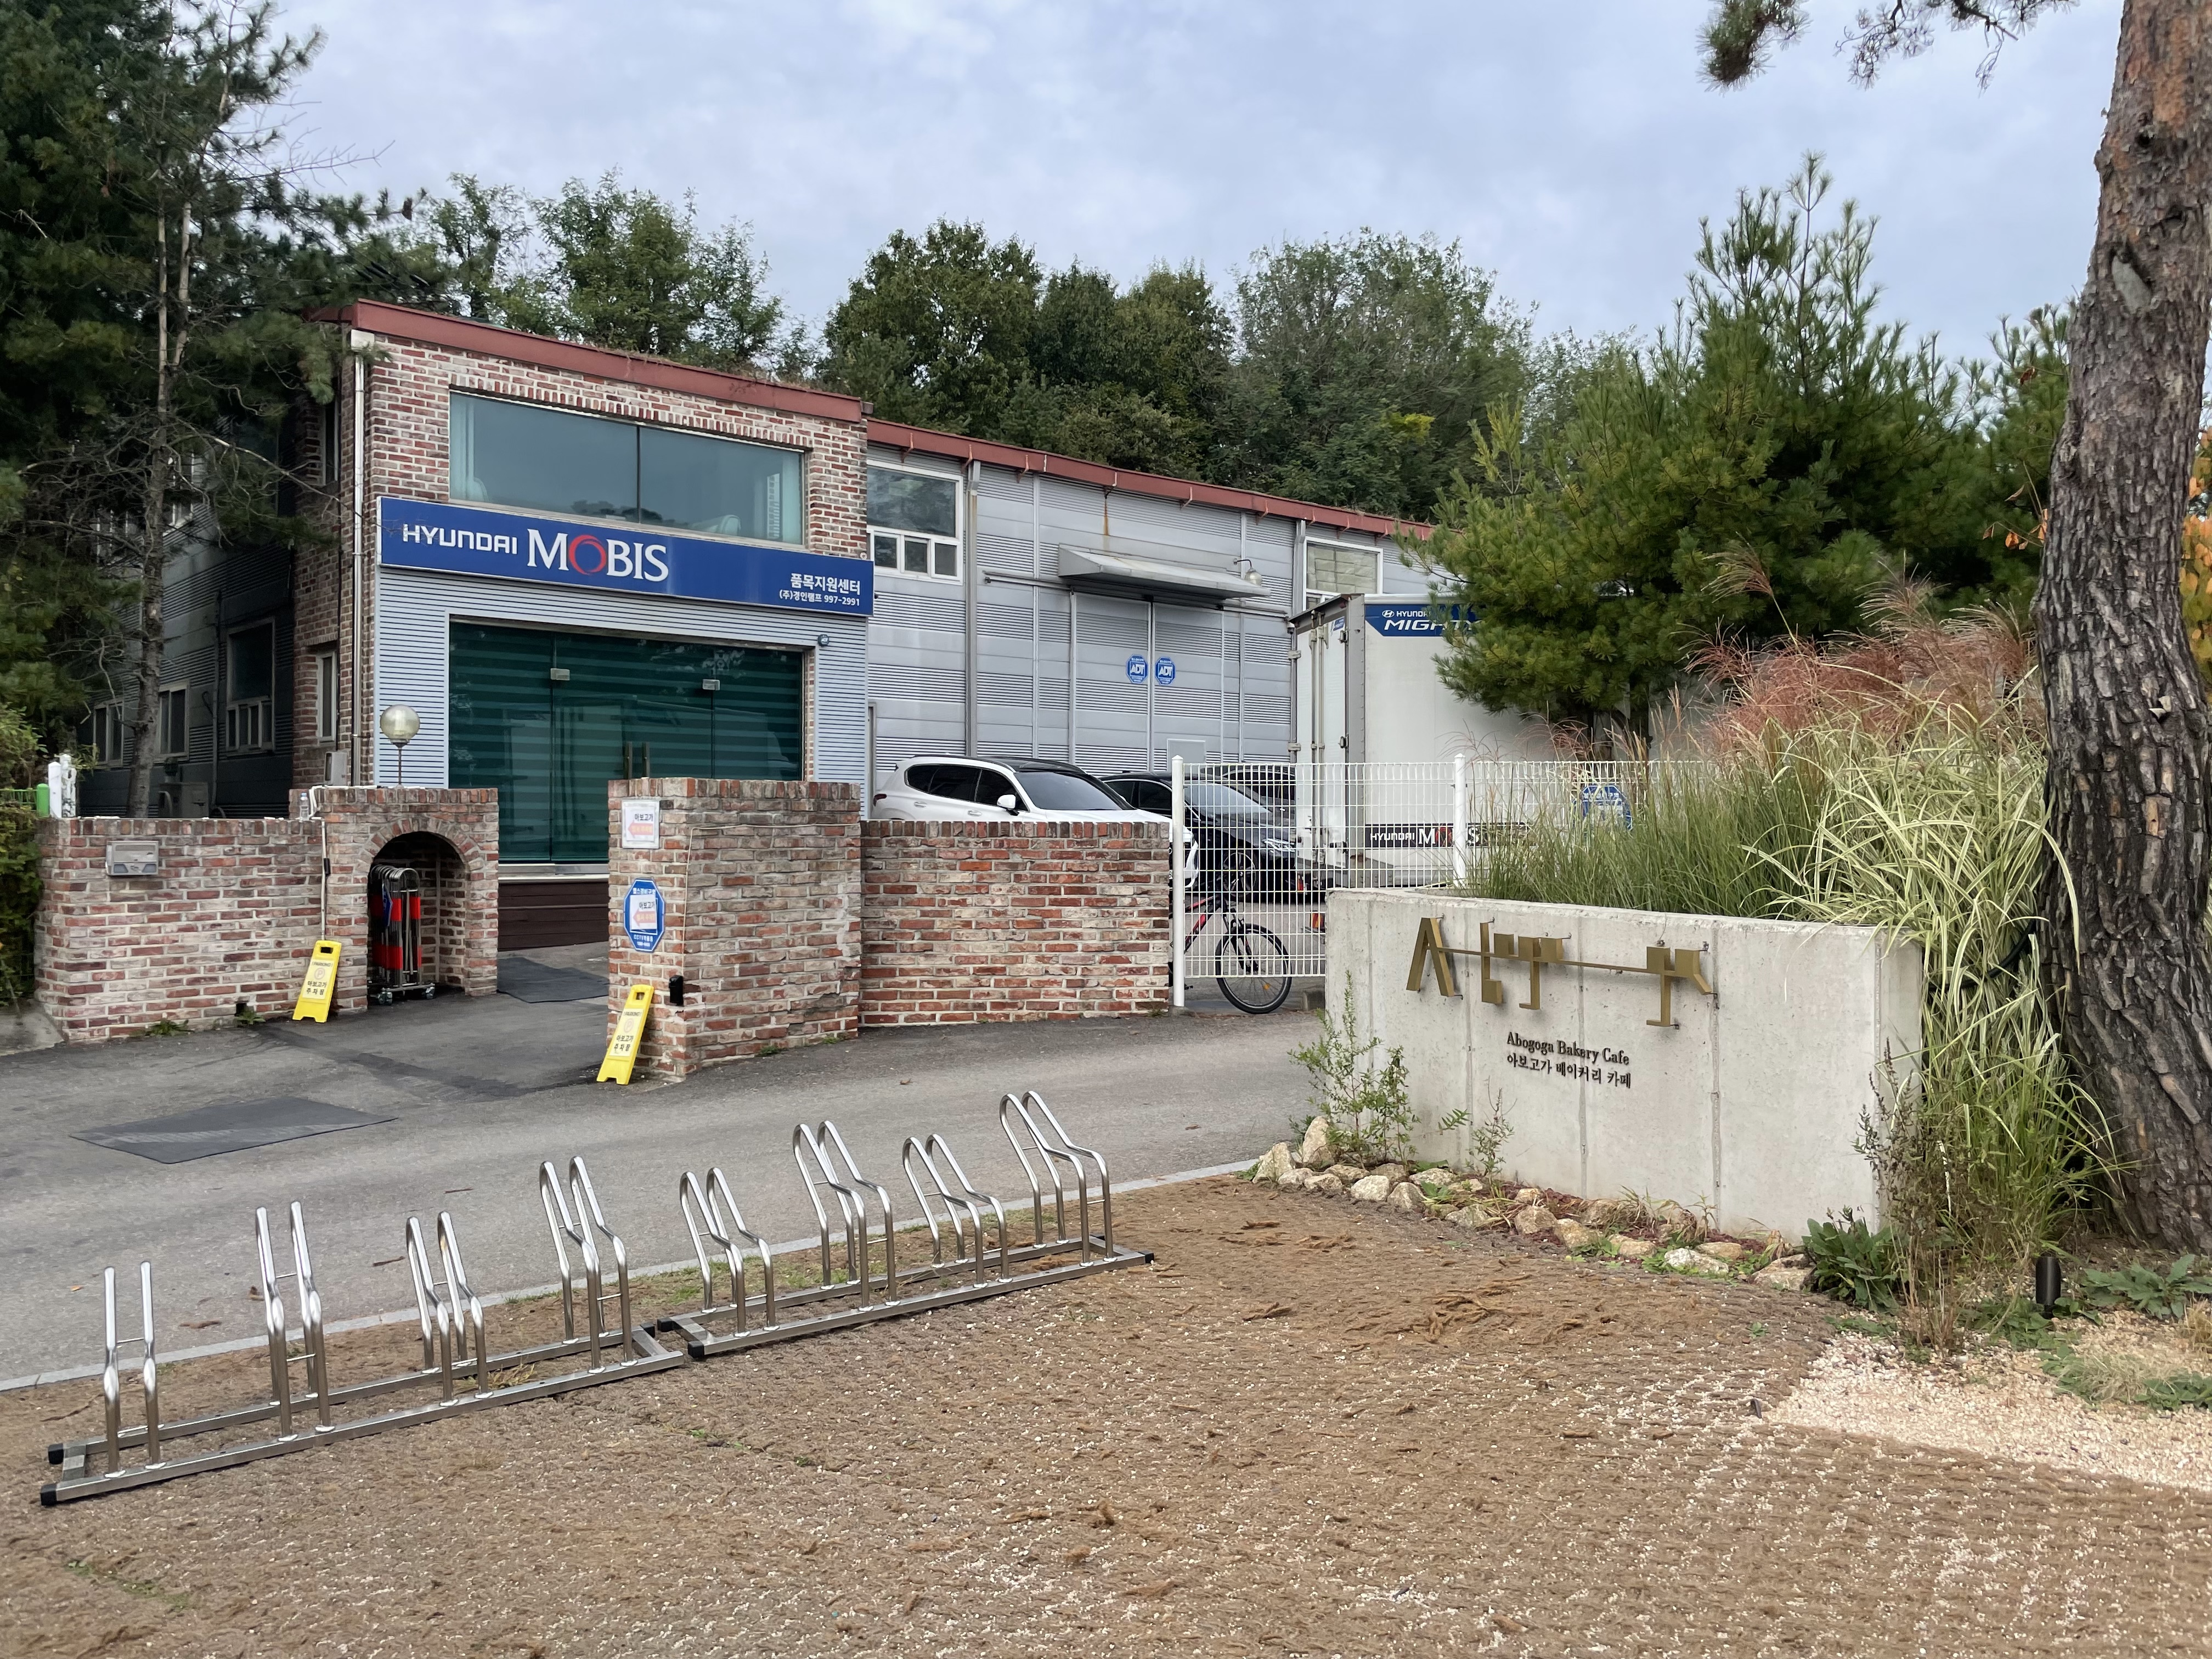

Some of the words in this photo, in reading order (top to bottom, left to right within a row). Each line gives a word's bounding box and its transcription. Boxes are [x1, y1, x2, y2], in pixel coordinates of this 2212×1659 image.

[402, 523, 517, 555] HYUNDAI
[527, 528, 669, 582] MOBIS
[791, 573, 860, 595] 품목지원센터
[824, 595, 860, 606] 997-2991
[1130, 663, 1145, 674] ADT
[1159, 665, 1173, 676] ADT
[634, 813, 653, 821] 아보고가
[1506, 1031, 1554, 1055] Abogoga
[1556, 1039, 1600, 1064] Bakery
[1602, 1047, 1630, 1065] Cafe
[1506, 1052, 1553, 1075] 아보고가
[1556, 1062, 1602, 1084] 베이커리
[1607, 1070, 1632, 1089] 카페
